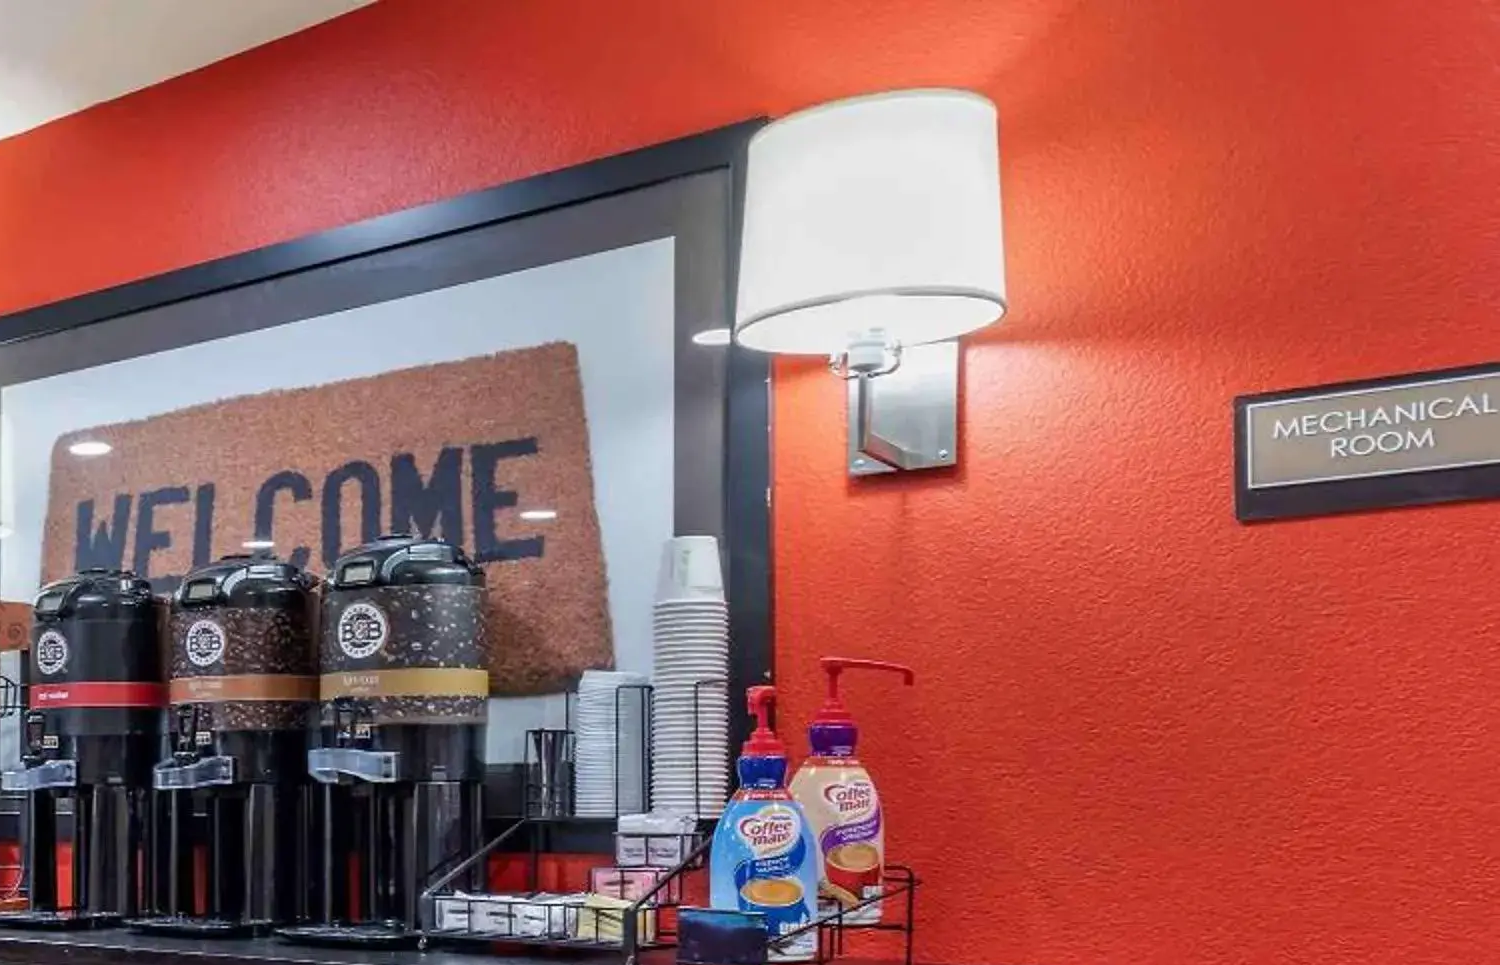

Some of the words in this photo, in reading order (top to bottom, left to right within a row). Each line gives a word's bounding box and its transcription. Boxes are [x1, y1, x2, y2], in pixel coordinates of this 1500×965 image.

[1272, 393, 1498, 440] MECHANICAL
[1330, 428, 1435, 458] ROOM
[75, 437, 545, 596] WELCOME
[824, 783, 871, 805] Coffee
[740, 817, 793, 837] Coffee
